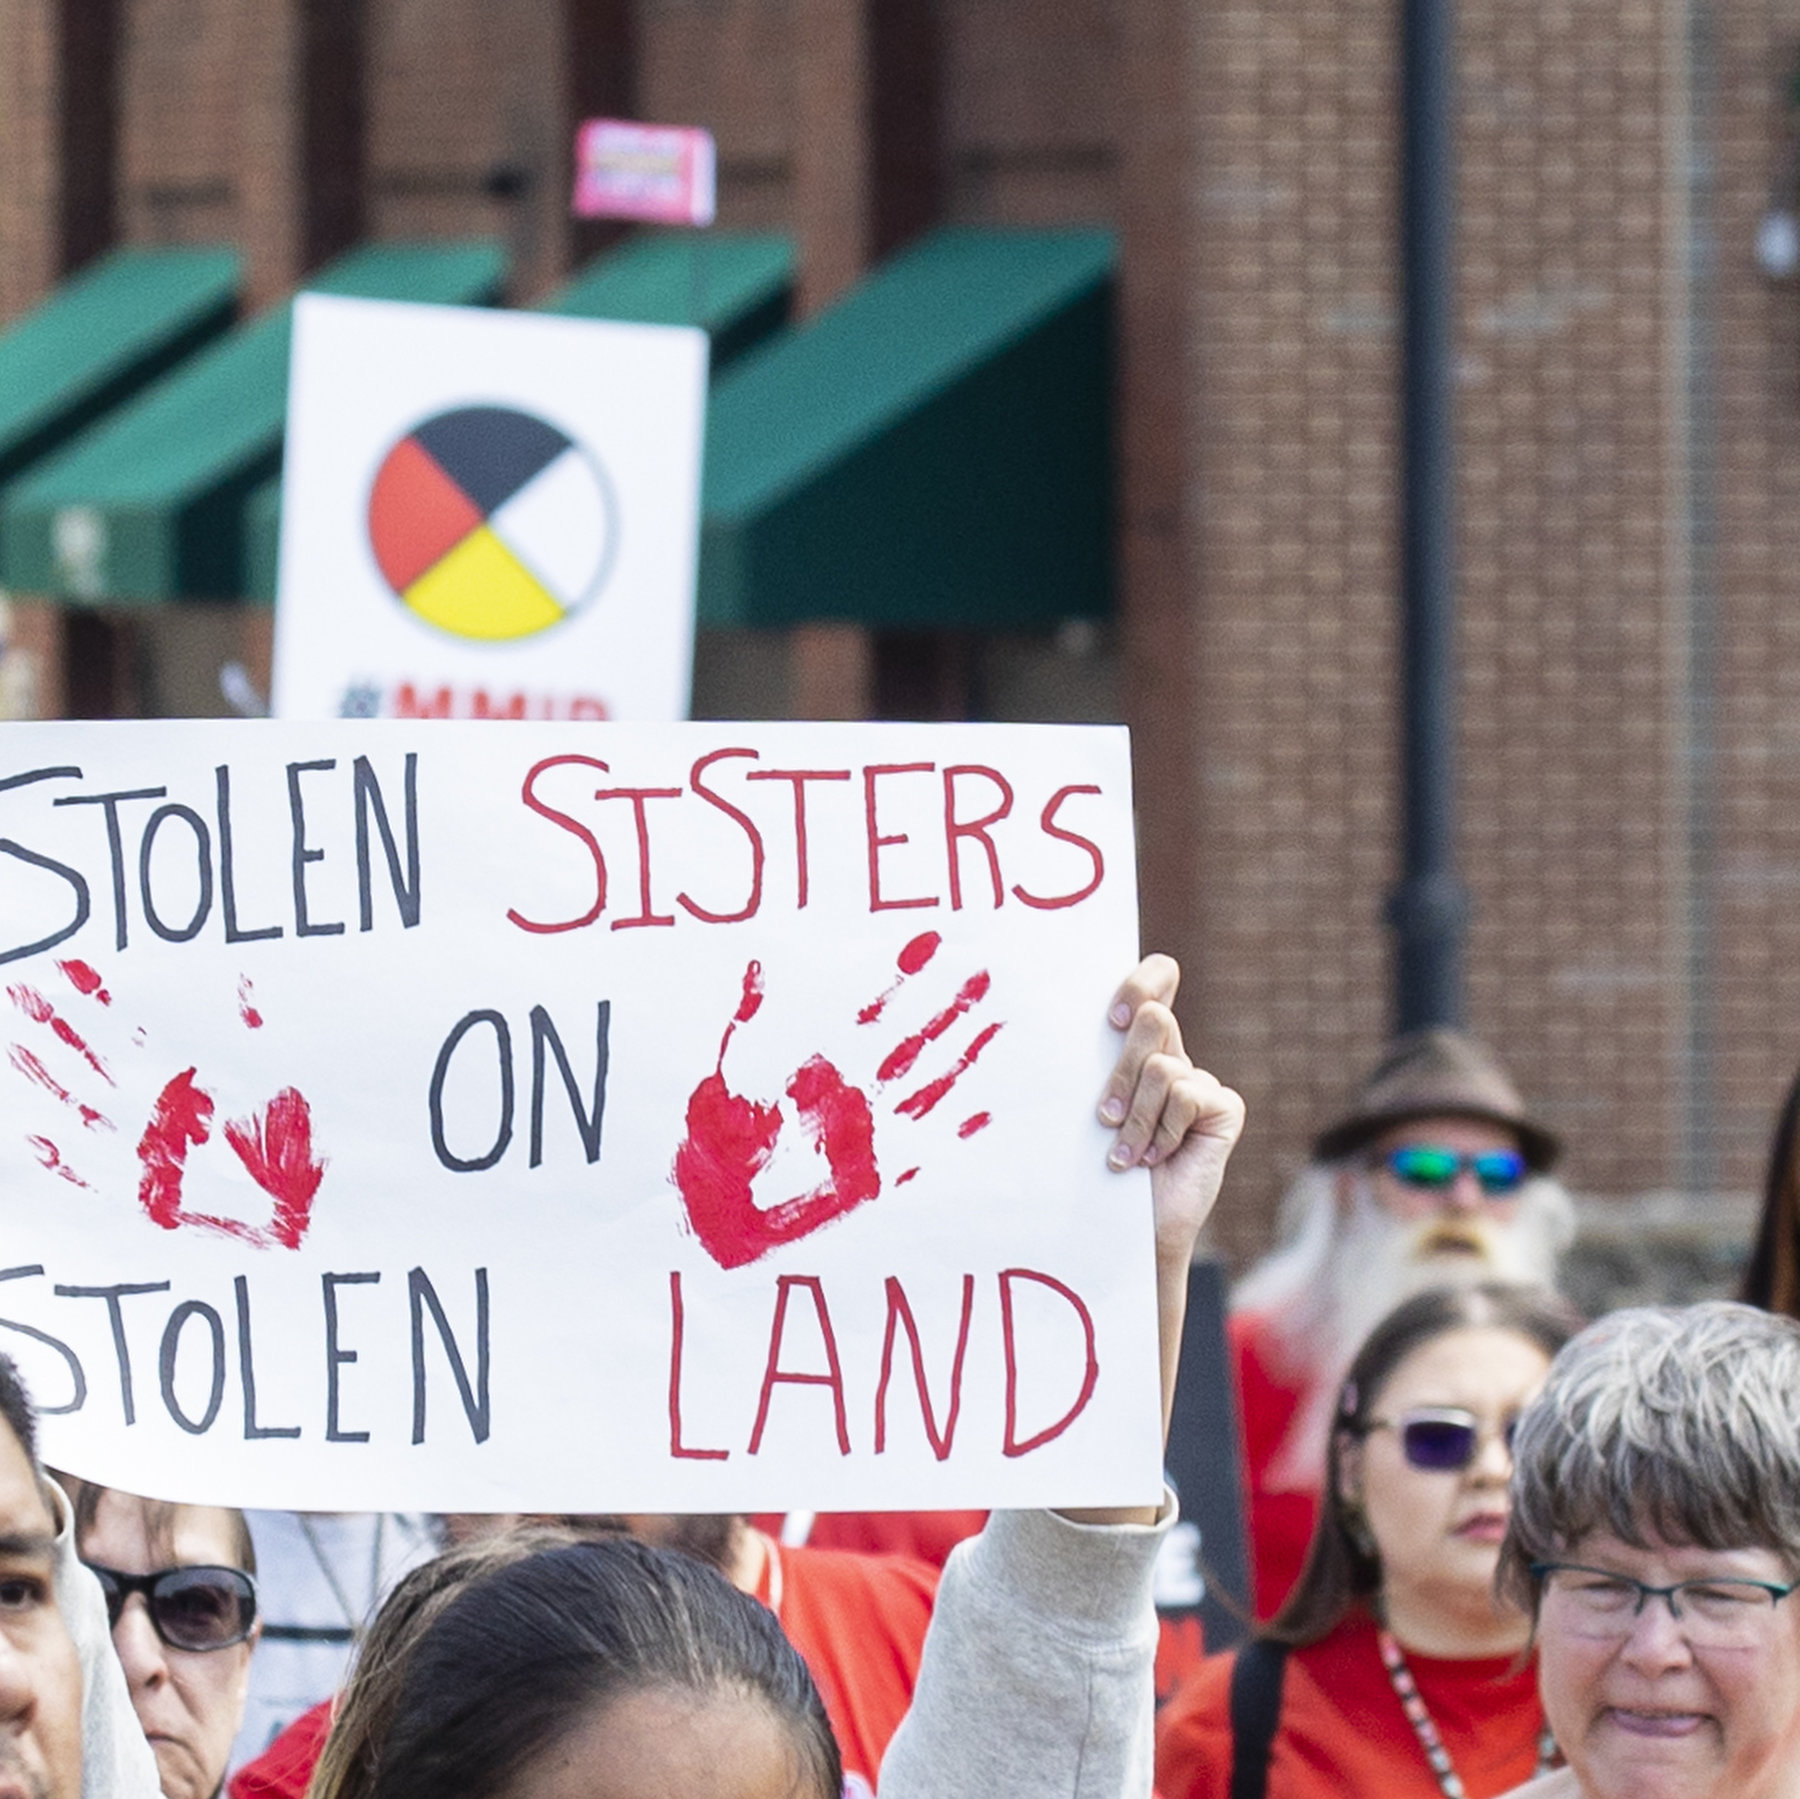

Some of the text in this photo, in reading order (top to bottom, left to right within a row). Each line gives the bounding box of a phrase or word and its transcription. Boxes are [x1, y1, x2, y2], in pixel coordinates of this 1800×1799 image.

[506, 748, 1104, 933] SISTERS
[428, 1000, 612, 1173] ON
[669, 1269, 1098, 1460] LAND
